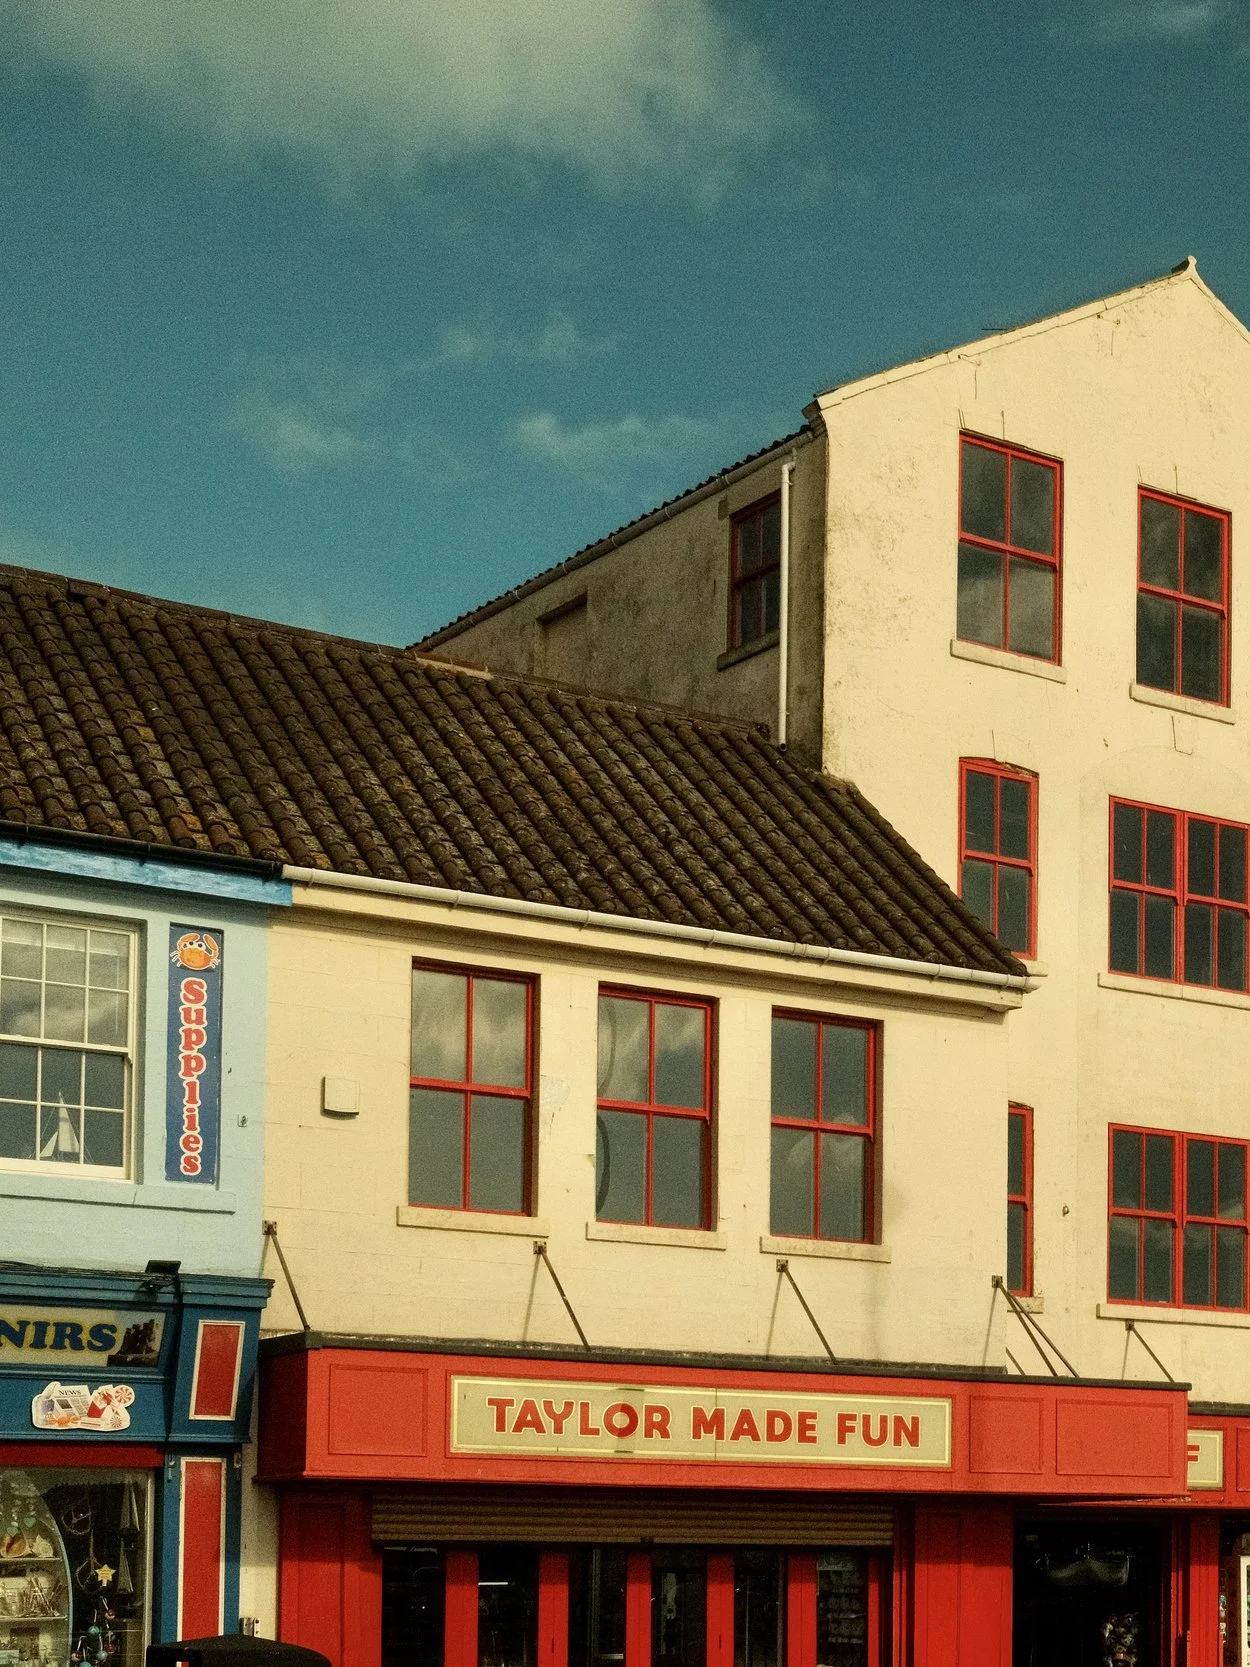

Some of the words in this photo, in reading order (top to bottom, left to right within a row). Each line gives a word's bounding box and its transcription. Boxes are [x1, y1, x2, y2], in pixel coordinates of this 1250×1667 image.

[180, 978, 207, 1175] Supplies
[487, 1397, 672, 1440] TAYLOR
[690, 1407, 819, 1445] MADE
[836, 1412, 922, 1449] FUN
